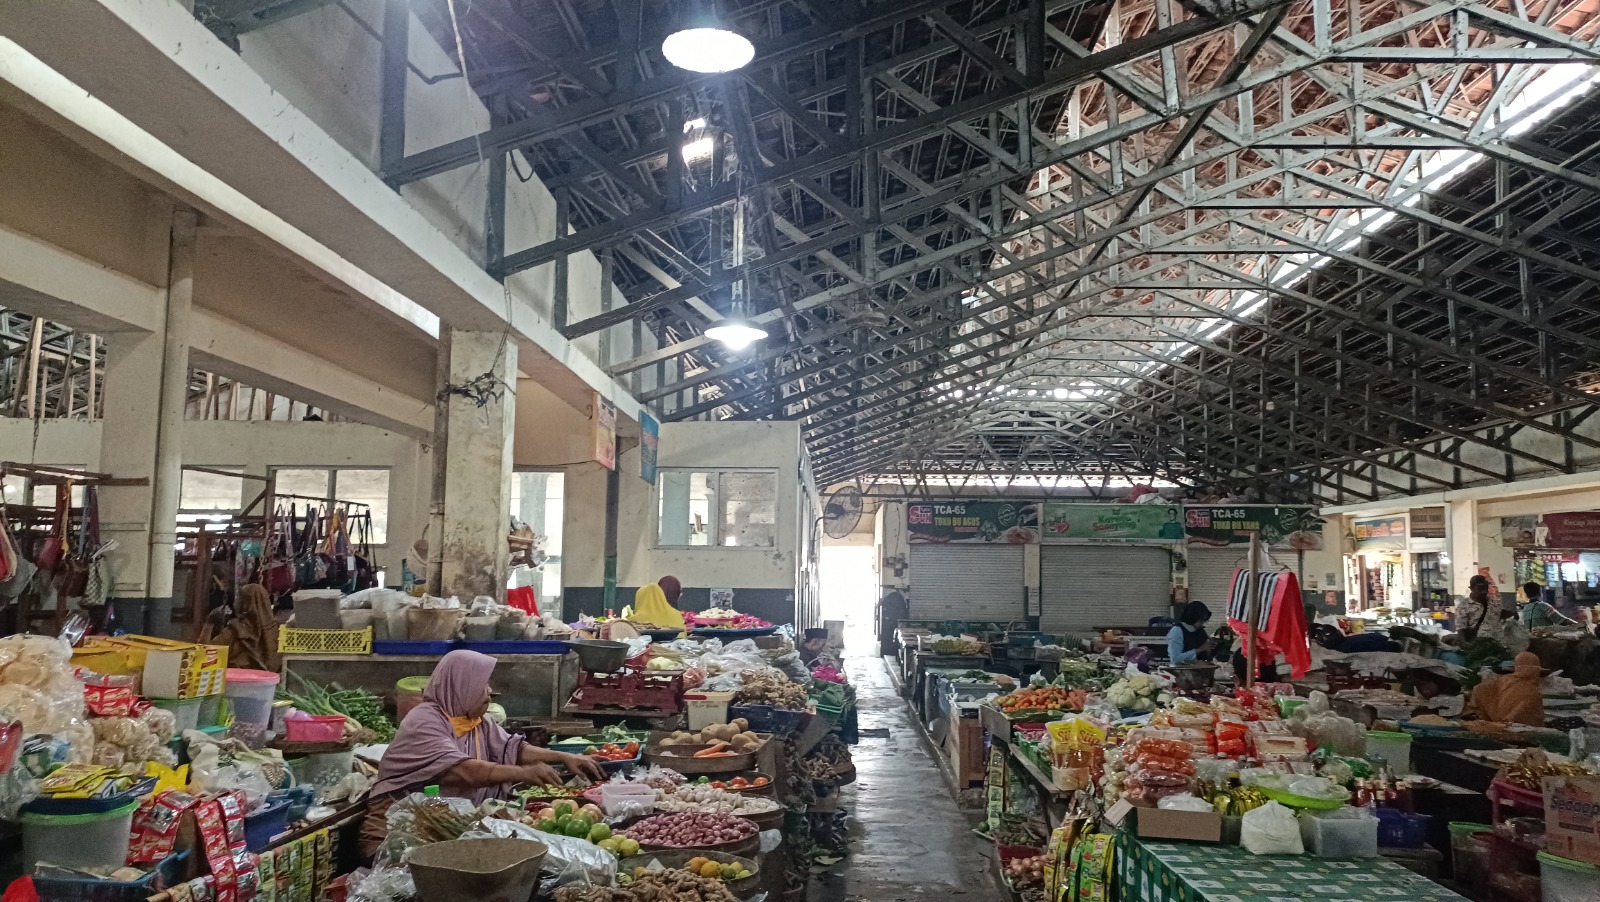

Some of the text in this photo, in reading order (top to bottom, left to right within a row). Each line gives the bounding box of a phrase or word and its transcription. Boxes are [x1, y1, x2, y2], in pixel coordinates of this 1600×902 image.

[934, 505, 965, 515] TCA-65
[1212, 509, 1245, 518] TCA-65
[934, 517, 980, 526] TOKO BU AGUS
[1212, 521, 1230, 530] TOKO
